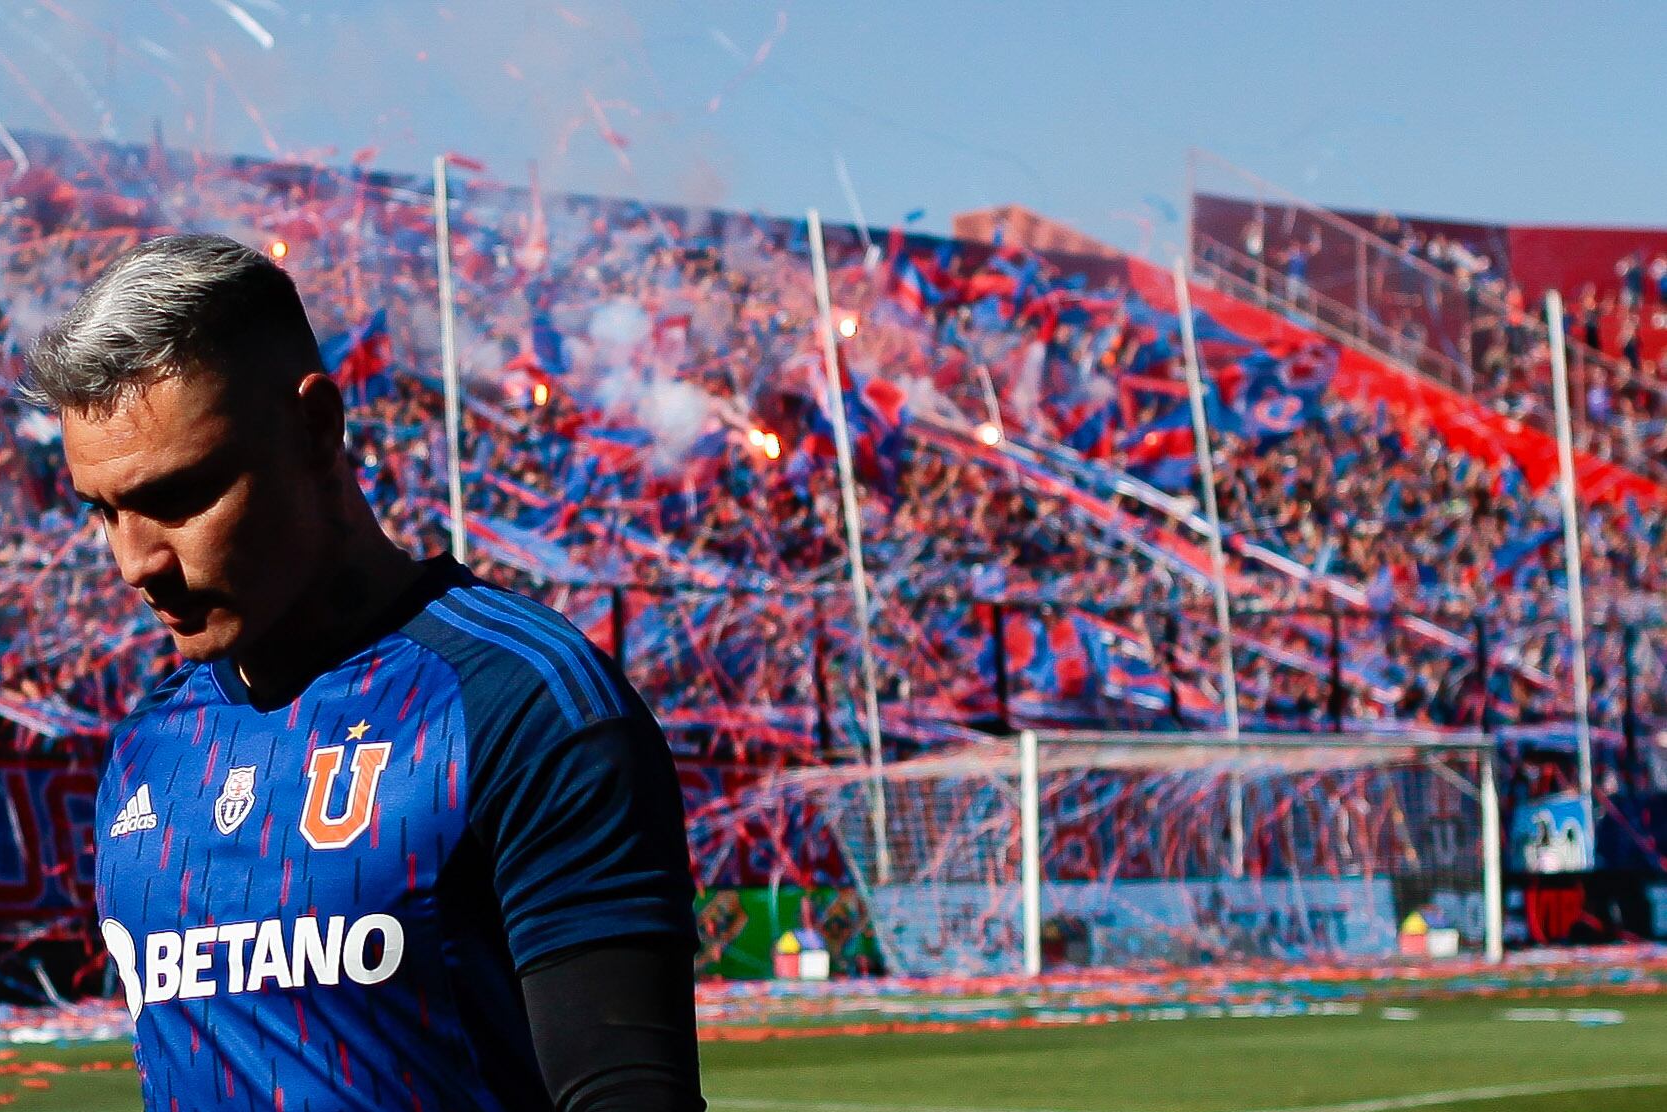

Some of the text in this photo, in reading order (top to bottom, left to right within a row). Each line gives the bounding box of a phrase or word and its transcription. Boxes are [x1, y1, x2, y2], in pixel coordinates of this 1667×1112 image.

[109, 812, 158, 838] adidas
[299, 741, 393, 851] U
[143, 912, 405, 1004] BETANO
